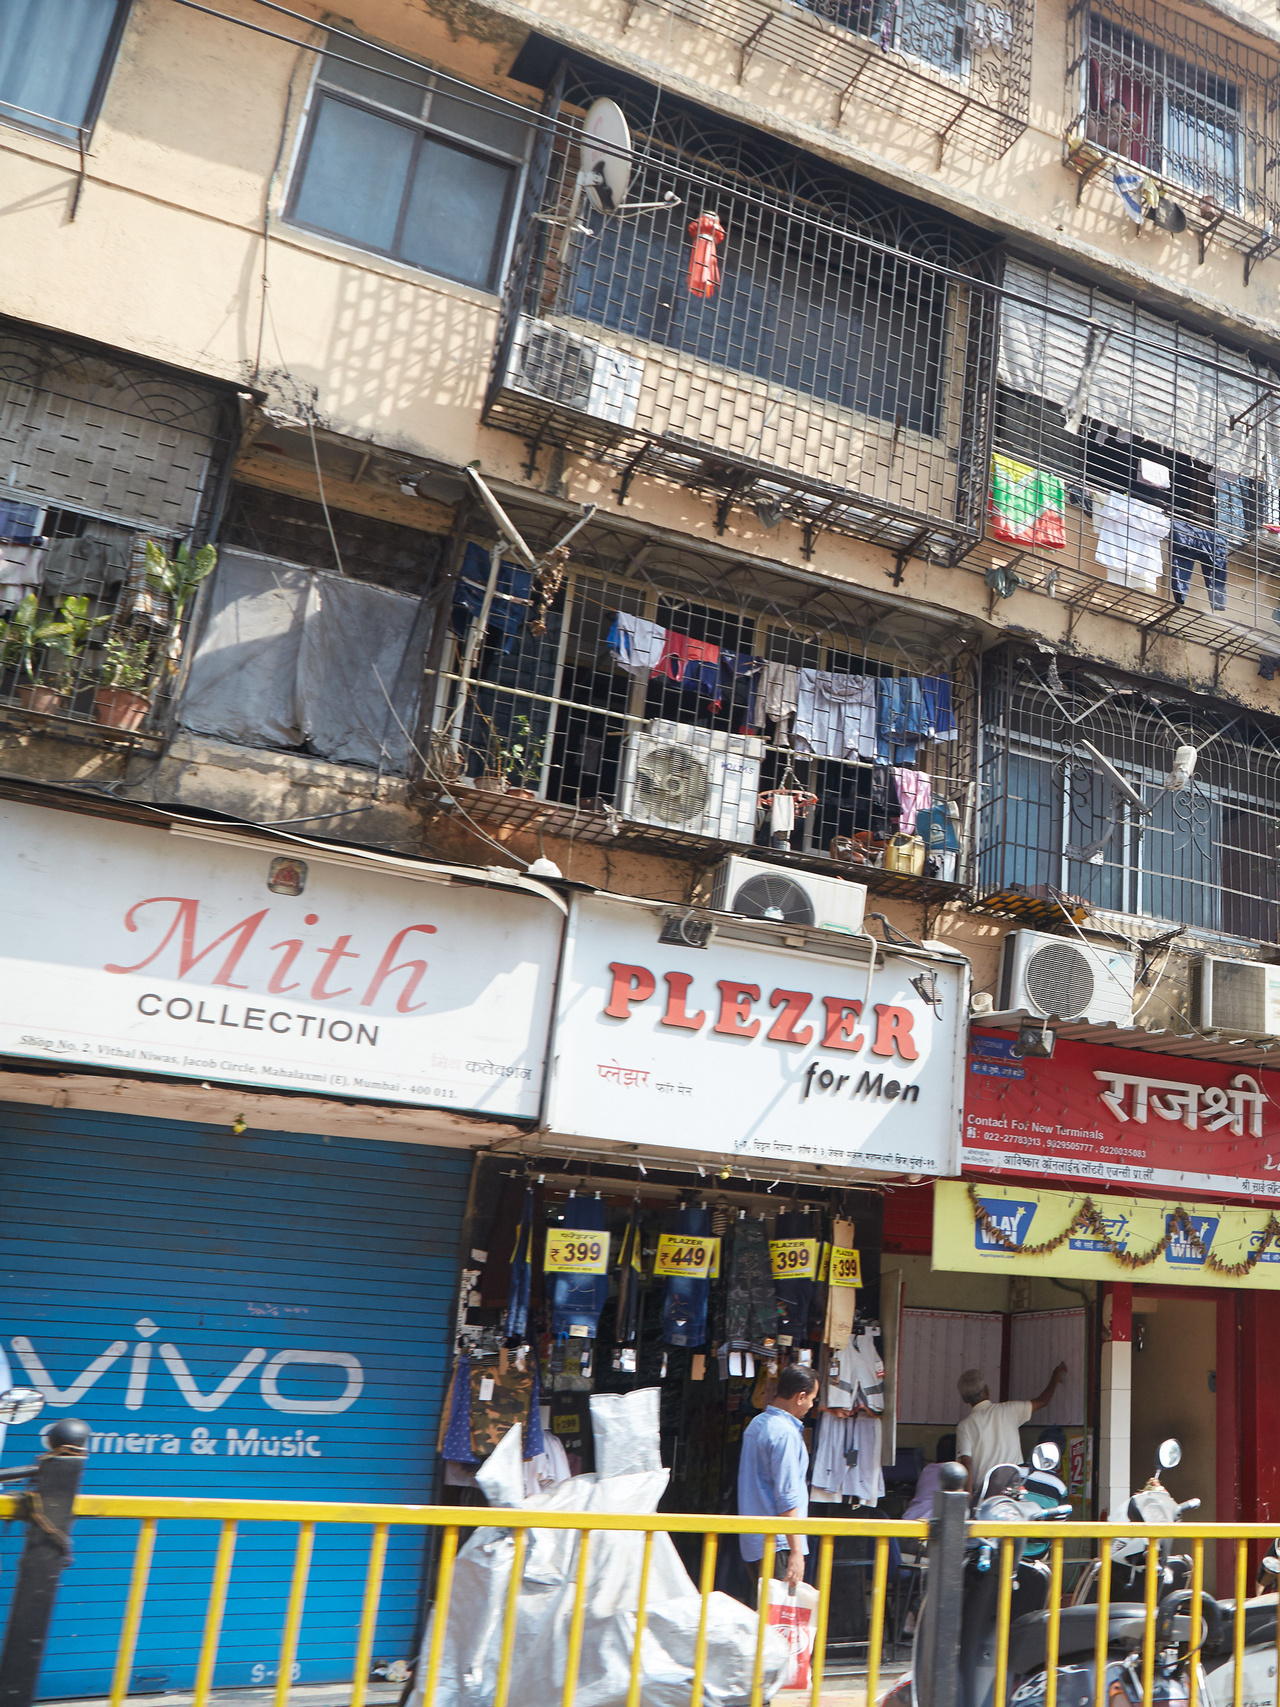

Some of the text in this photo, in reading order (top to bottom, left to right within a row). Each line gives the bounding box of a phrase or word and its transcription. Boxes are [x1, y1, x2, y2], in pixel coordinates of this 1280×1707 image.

[104, 897, 437, 1013] Mith
[137, 993, 379, 1046] COLLECTION
[604, 961, 921, 1060] PLEZER
[20, 1035, 53, 1049] Shop
[57, 1039, 78, 1051] No.
[98, 1044, 136, 1059] Vithal
[140, 1051, 180, 1065] Niwas,
[182, 1056, 217, 1069] Jacob
[220, 1060, 258, 1074] Circle,
[262, 1065, 328, 1083] Mahalaxmi
[353, 1077, 400, 1092] Mumbai
[410, 1085, 431, 1097] 400
[597, 1058, 650, 1089] प्लेझर
[804, 1061, 920, 1103] for Men
[1092, 1072, 1270, 1139] राजश्री
[967, 1114, 1104, 1140] Contact For New Terminals
[982, 1213, 1020, 1232] LAY
[667, 1236, 704, 1246] PLAZER
[769, 1241, 805, 1249] PLAZER
[981, 1229, 1018, 1245] WN
[1171, 1228, 1207, 1244] PLY
[564, 1242, 601, 1263] 399
[670, 1247, 706, 1267] 449
[777, 1249, 809, 1270] 399
[838, 1259, 858, 1278] 399
[10, 1317, 365, 1415] vivo
[38, 1422, 322, 1457] Cmera & Music
[250, 1662, 301, 1684] S-8
